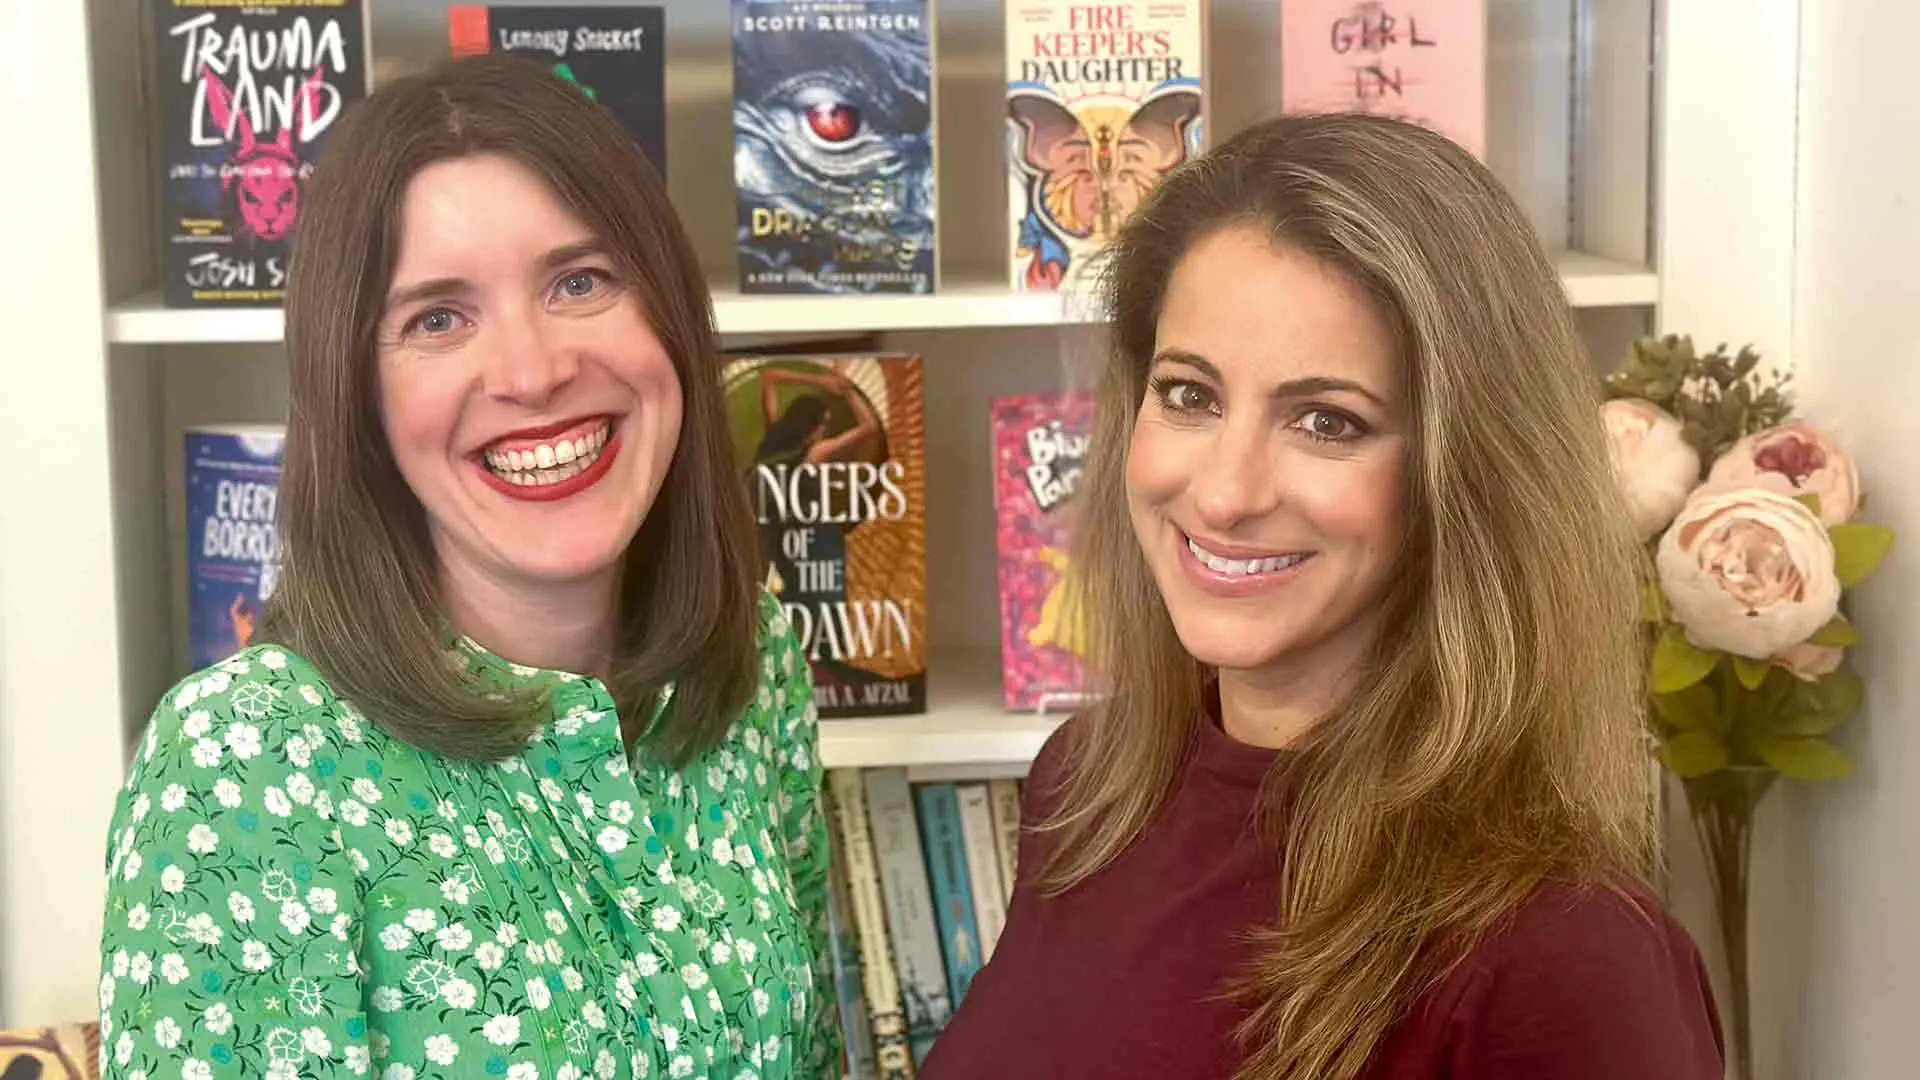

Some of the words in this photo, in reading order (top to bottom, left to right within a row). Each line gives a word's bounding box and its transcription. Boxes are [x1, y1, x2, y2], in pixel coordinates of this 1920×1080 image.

[743, 15, 806, 32] SCOTT
[816, 14, 920, 31] REINTGEN
[1069, 4, 1134, 29] FIRE
[1331, 12, 1437, 54] GIRL
[169, 12, 346, 83] TRAUMA
[1033, 30, 1171, 57] KEEPER'S
[1021, 57, 1183, 83] DAUGHTER
[190, 70, 342, 146] LAND
[186, 252, 255, 287] JOSH
[757, 460, 907, 525] NCERS
[203, 516, 281, 562] BORRO
[783, 527, 815, 560] OF
[795, 560, 843, 593] THE
[783, 599, 912, 662] DAWN
